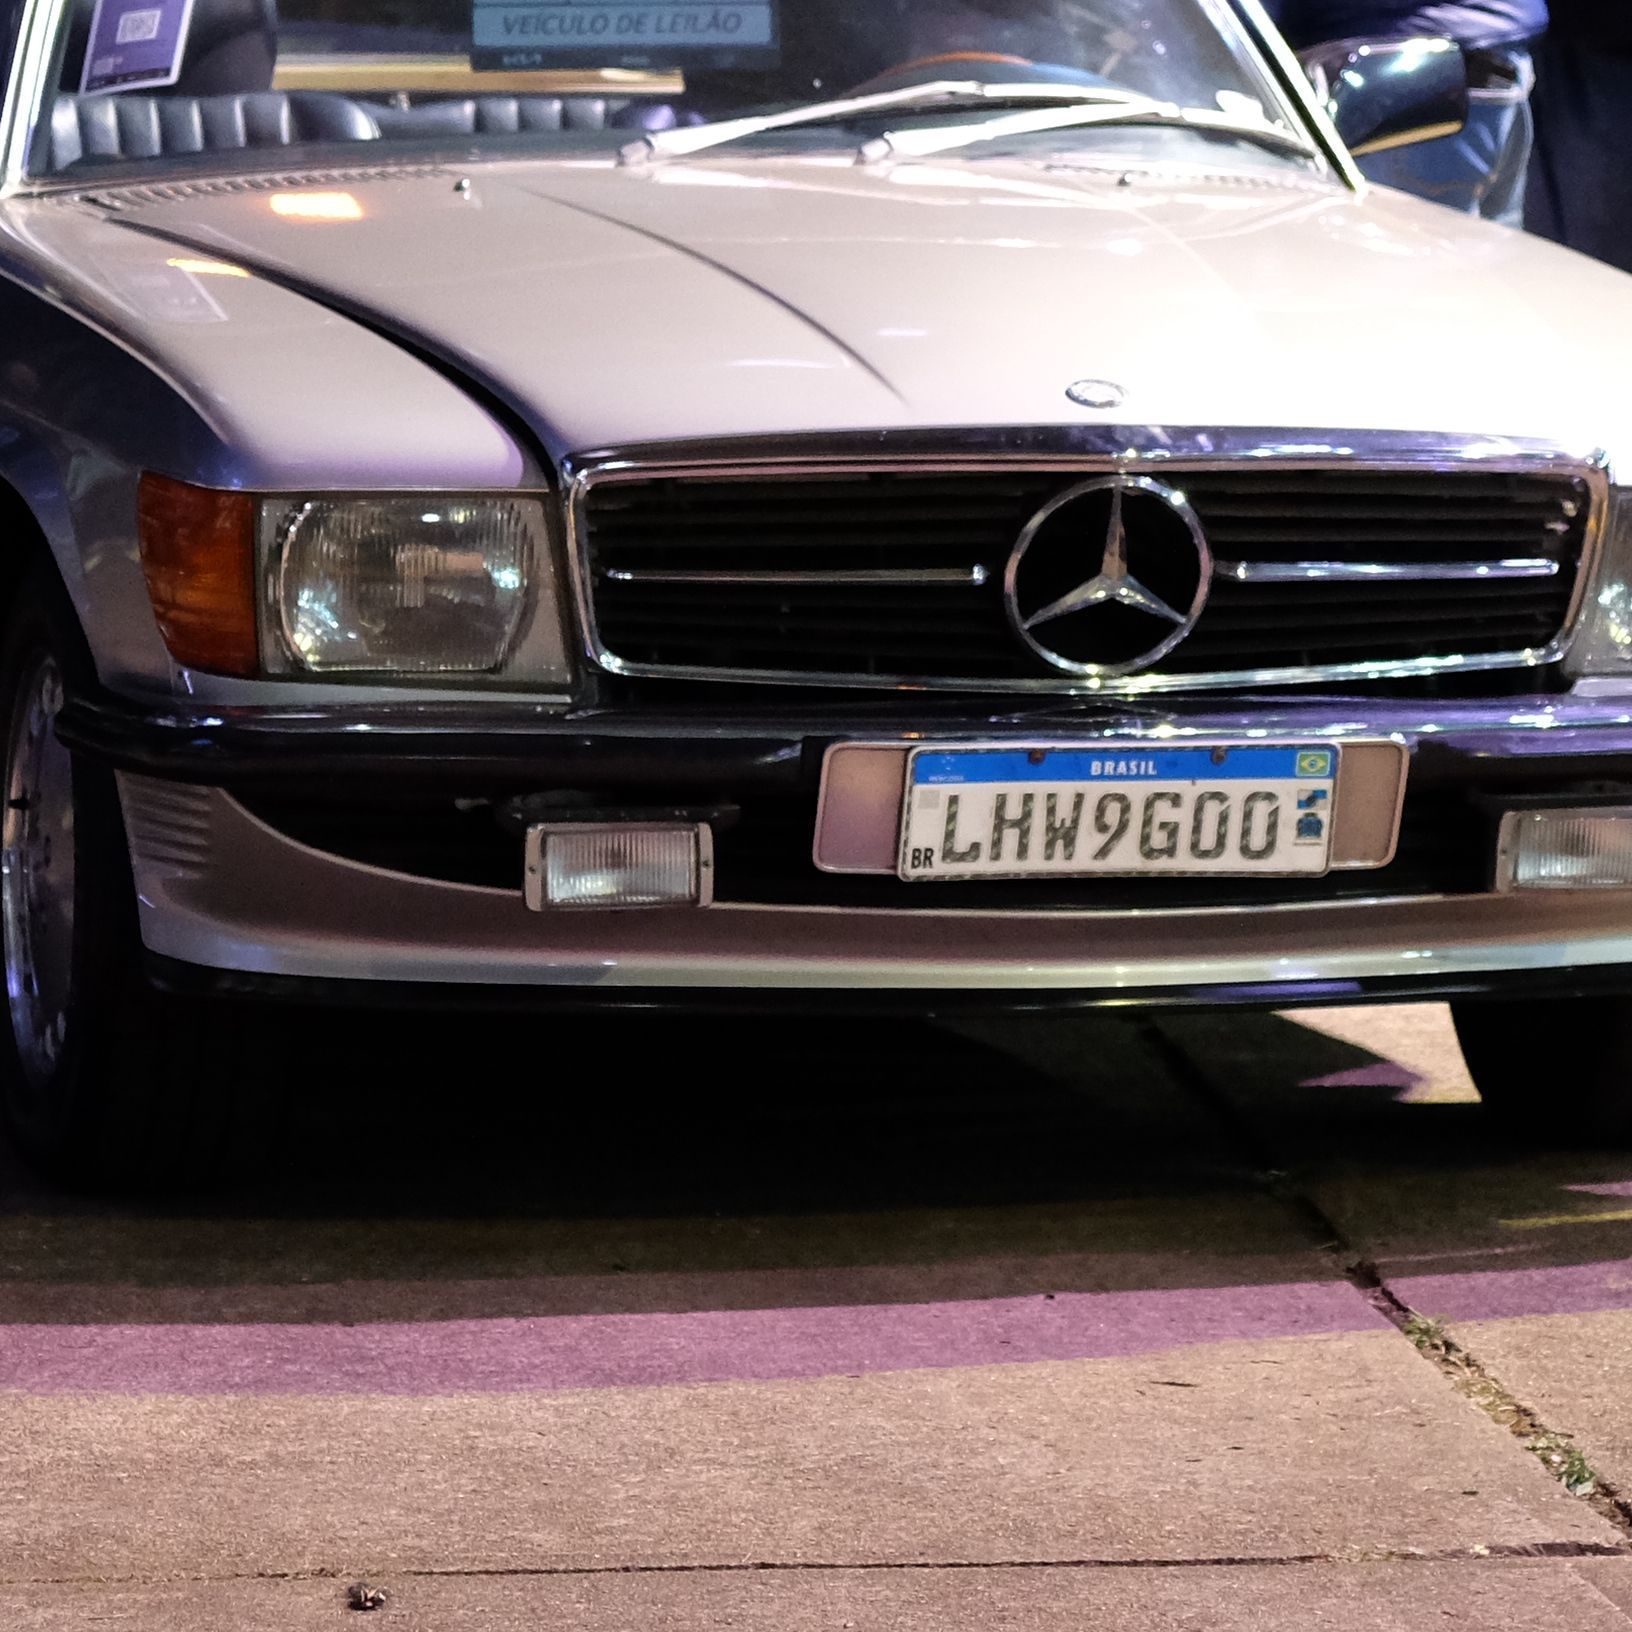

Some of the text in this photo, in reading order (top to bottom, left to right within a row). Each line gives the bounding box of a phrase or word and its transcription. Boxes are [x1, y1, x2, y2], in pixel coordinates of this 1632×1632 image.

[501, 9, 743, 37] VEÍCULO DE LEILÃO
[1090, 759, 1158, 776] BRASIL
[941, 792, 1280, 864] LHW9G00
[910, 847, 935, 869] BR
